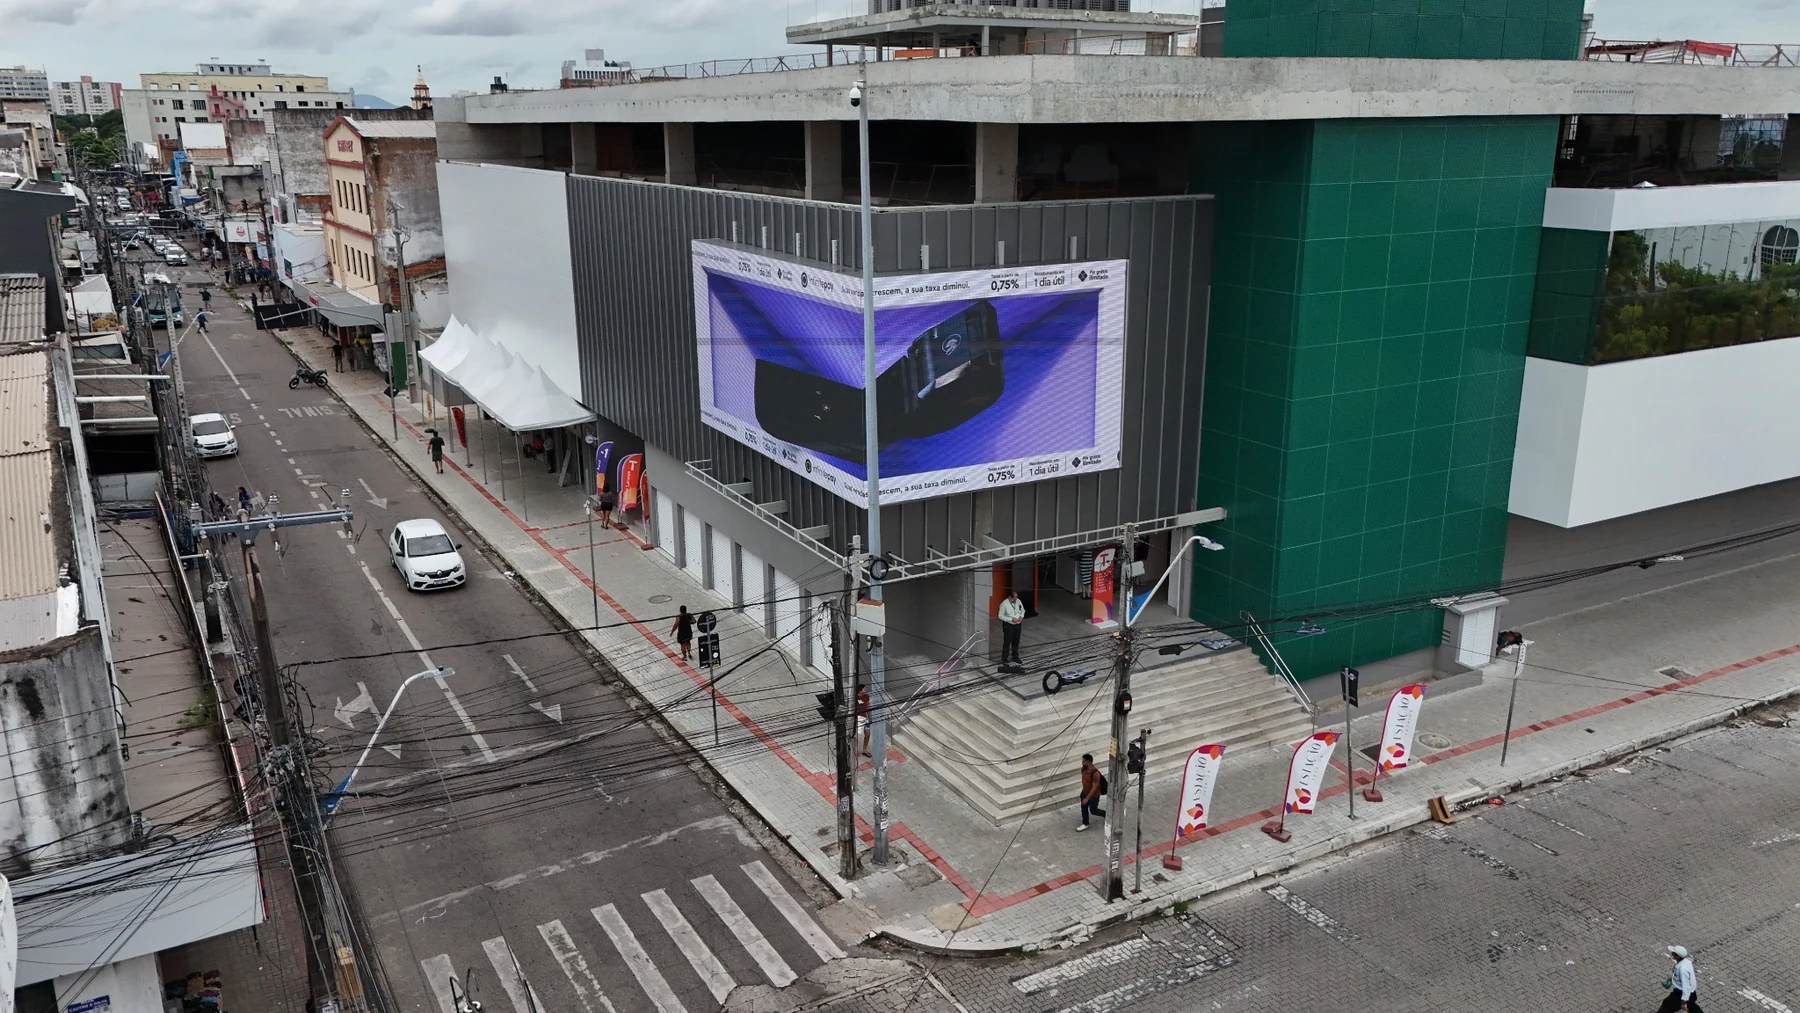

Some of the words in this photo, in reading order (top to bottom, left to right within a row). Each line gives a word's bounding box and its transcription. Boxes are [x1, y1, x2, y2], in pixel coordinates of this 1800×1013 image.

[809, 276, 834, 292] infinitepay
[942, 281, 970, 290] diminui.
[991, 279, 1020, 292] 0,75%
[1034, 279, 1038, 287] 1
[1040, 277, 1051, 286] dia
[1052, 275, 1065, 285] útil
[278, 405, 334, 418] SINAL
[813, 466, 836, 485] infinitepay
[1034, 466, 1046, 475] dia
[1048, 463, 1059, 473] útil
[988, 470, 1015, 484] 0,75%
[878, 488, 903, 496] escem,
[941, 476, 968, 486] diminui.
[1100, 553, 1108, 566] T
